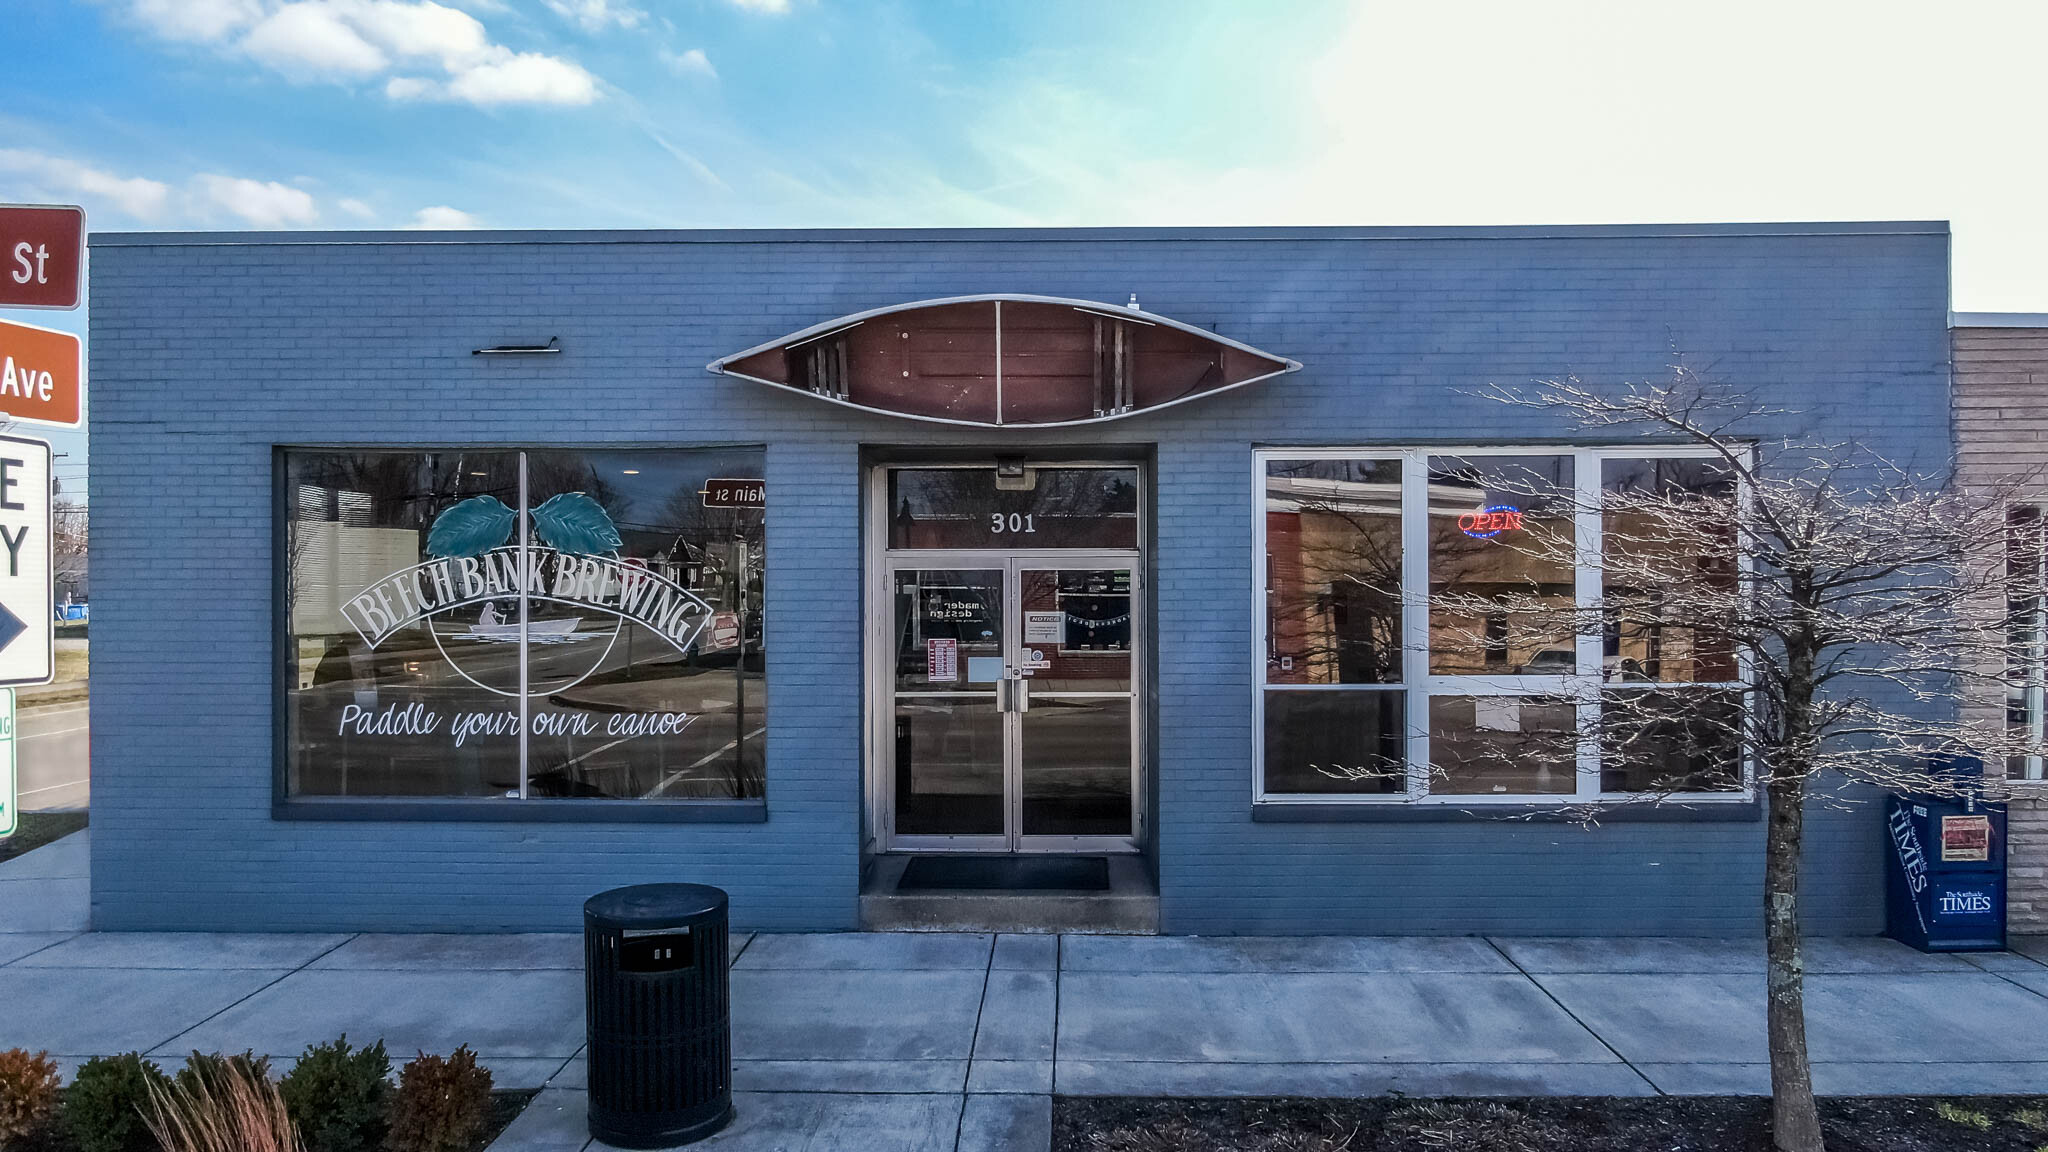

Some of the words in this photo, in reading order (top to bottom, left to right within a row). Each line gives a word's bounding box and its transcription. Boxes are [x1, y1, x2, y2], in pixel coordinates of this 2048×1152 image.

[13, 242, 49, 284] St
[1, 356, 53, 402] Ave
[0, 457, 25, 511] E
[991, 512, 1036, 533] 301
[1458, 512, 1522, 531] OPEN
[0, 524, 29, 577] Y
[352, 560, 457, 641] BEECH
[459, 551, 550, 600] BANK
[551, 553, 701, 645] BREWING
[338, 702, 443, 736] Paddle
[451, 711, 521, 748] your
[532, 712, 600, 737] own
[606, 712, 700, 736] canoe
[1890, 802, 1928, 893] TIMES
[1939, 897, 1991, 911] TIMES
